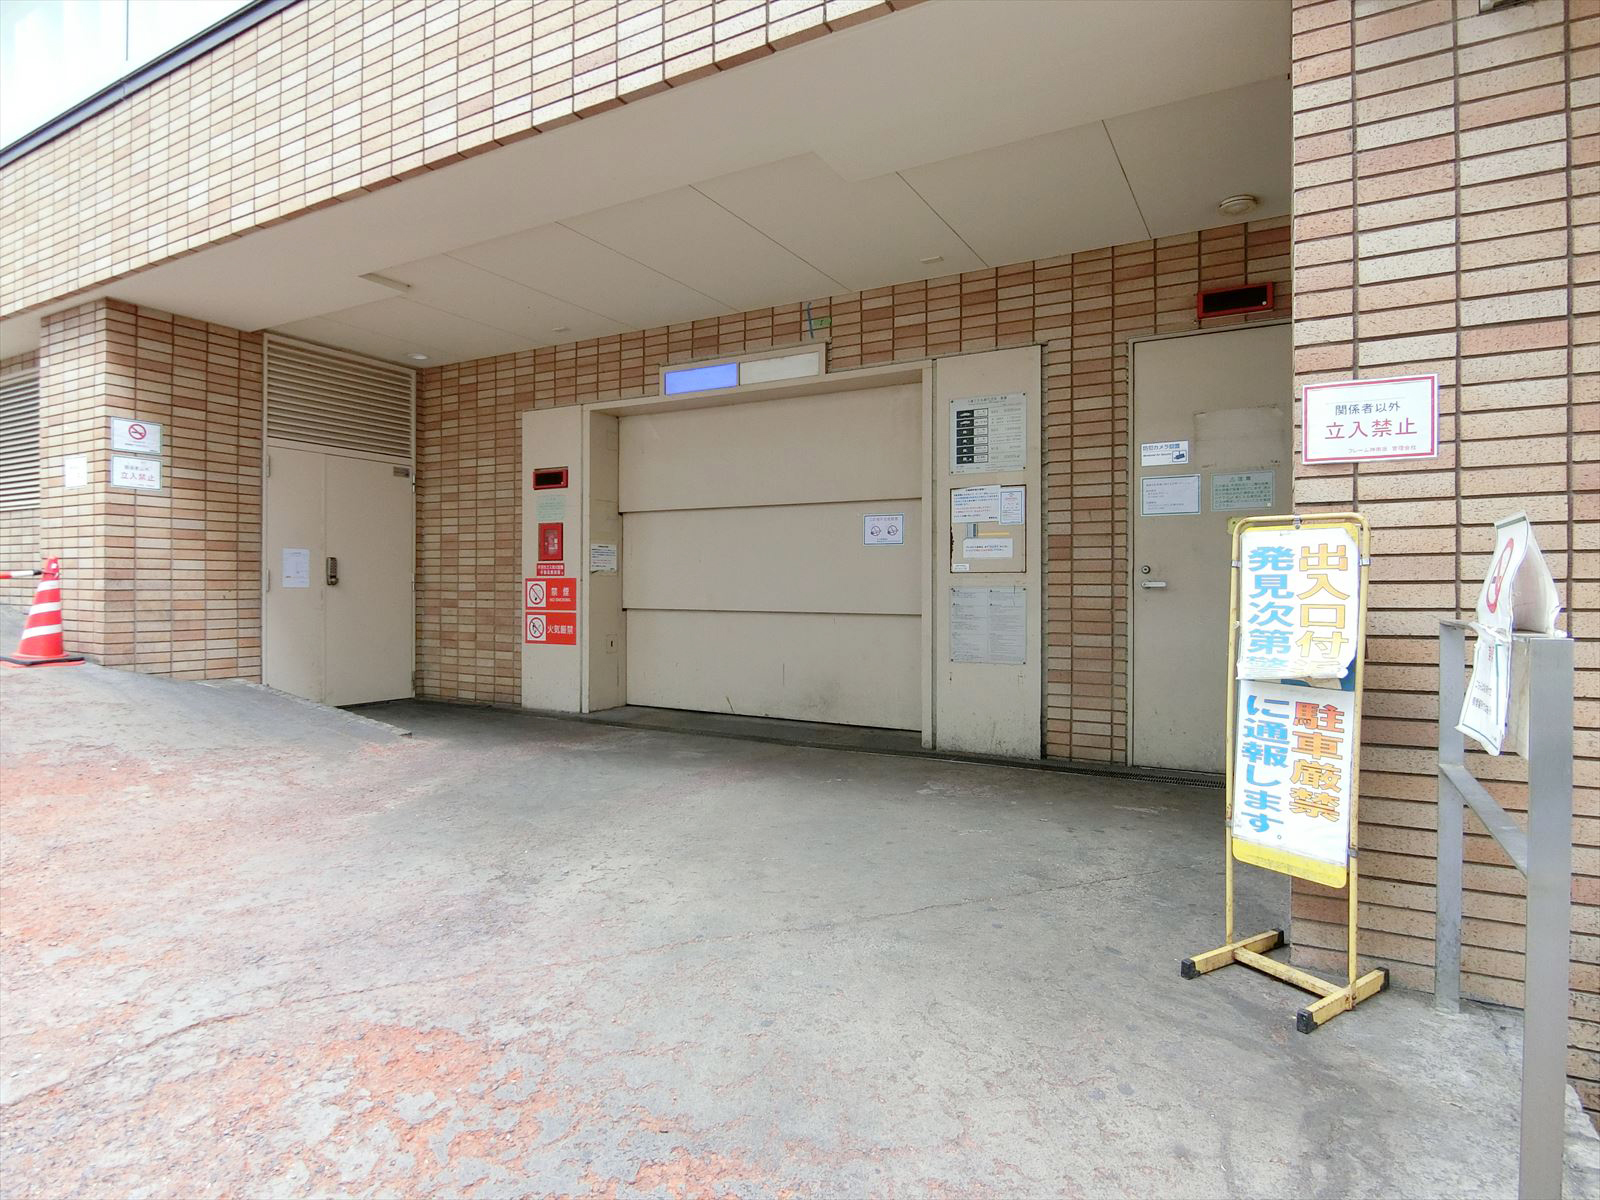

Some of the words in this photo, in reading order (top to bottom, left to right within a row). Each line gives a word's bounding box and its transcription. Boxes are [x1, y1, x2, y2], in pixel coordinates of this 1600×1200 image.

[1335, 401, 1401, 416] 関係者以外
[1325, 417, 1417, 440] 立入禁止
[120, 471, 156, 482] 立入禁止
[1241, 694, 1290, 840] に通報します。
[1288, 701, 1345, 823] 駐車厳禁
